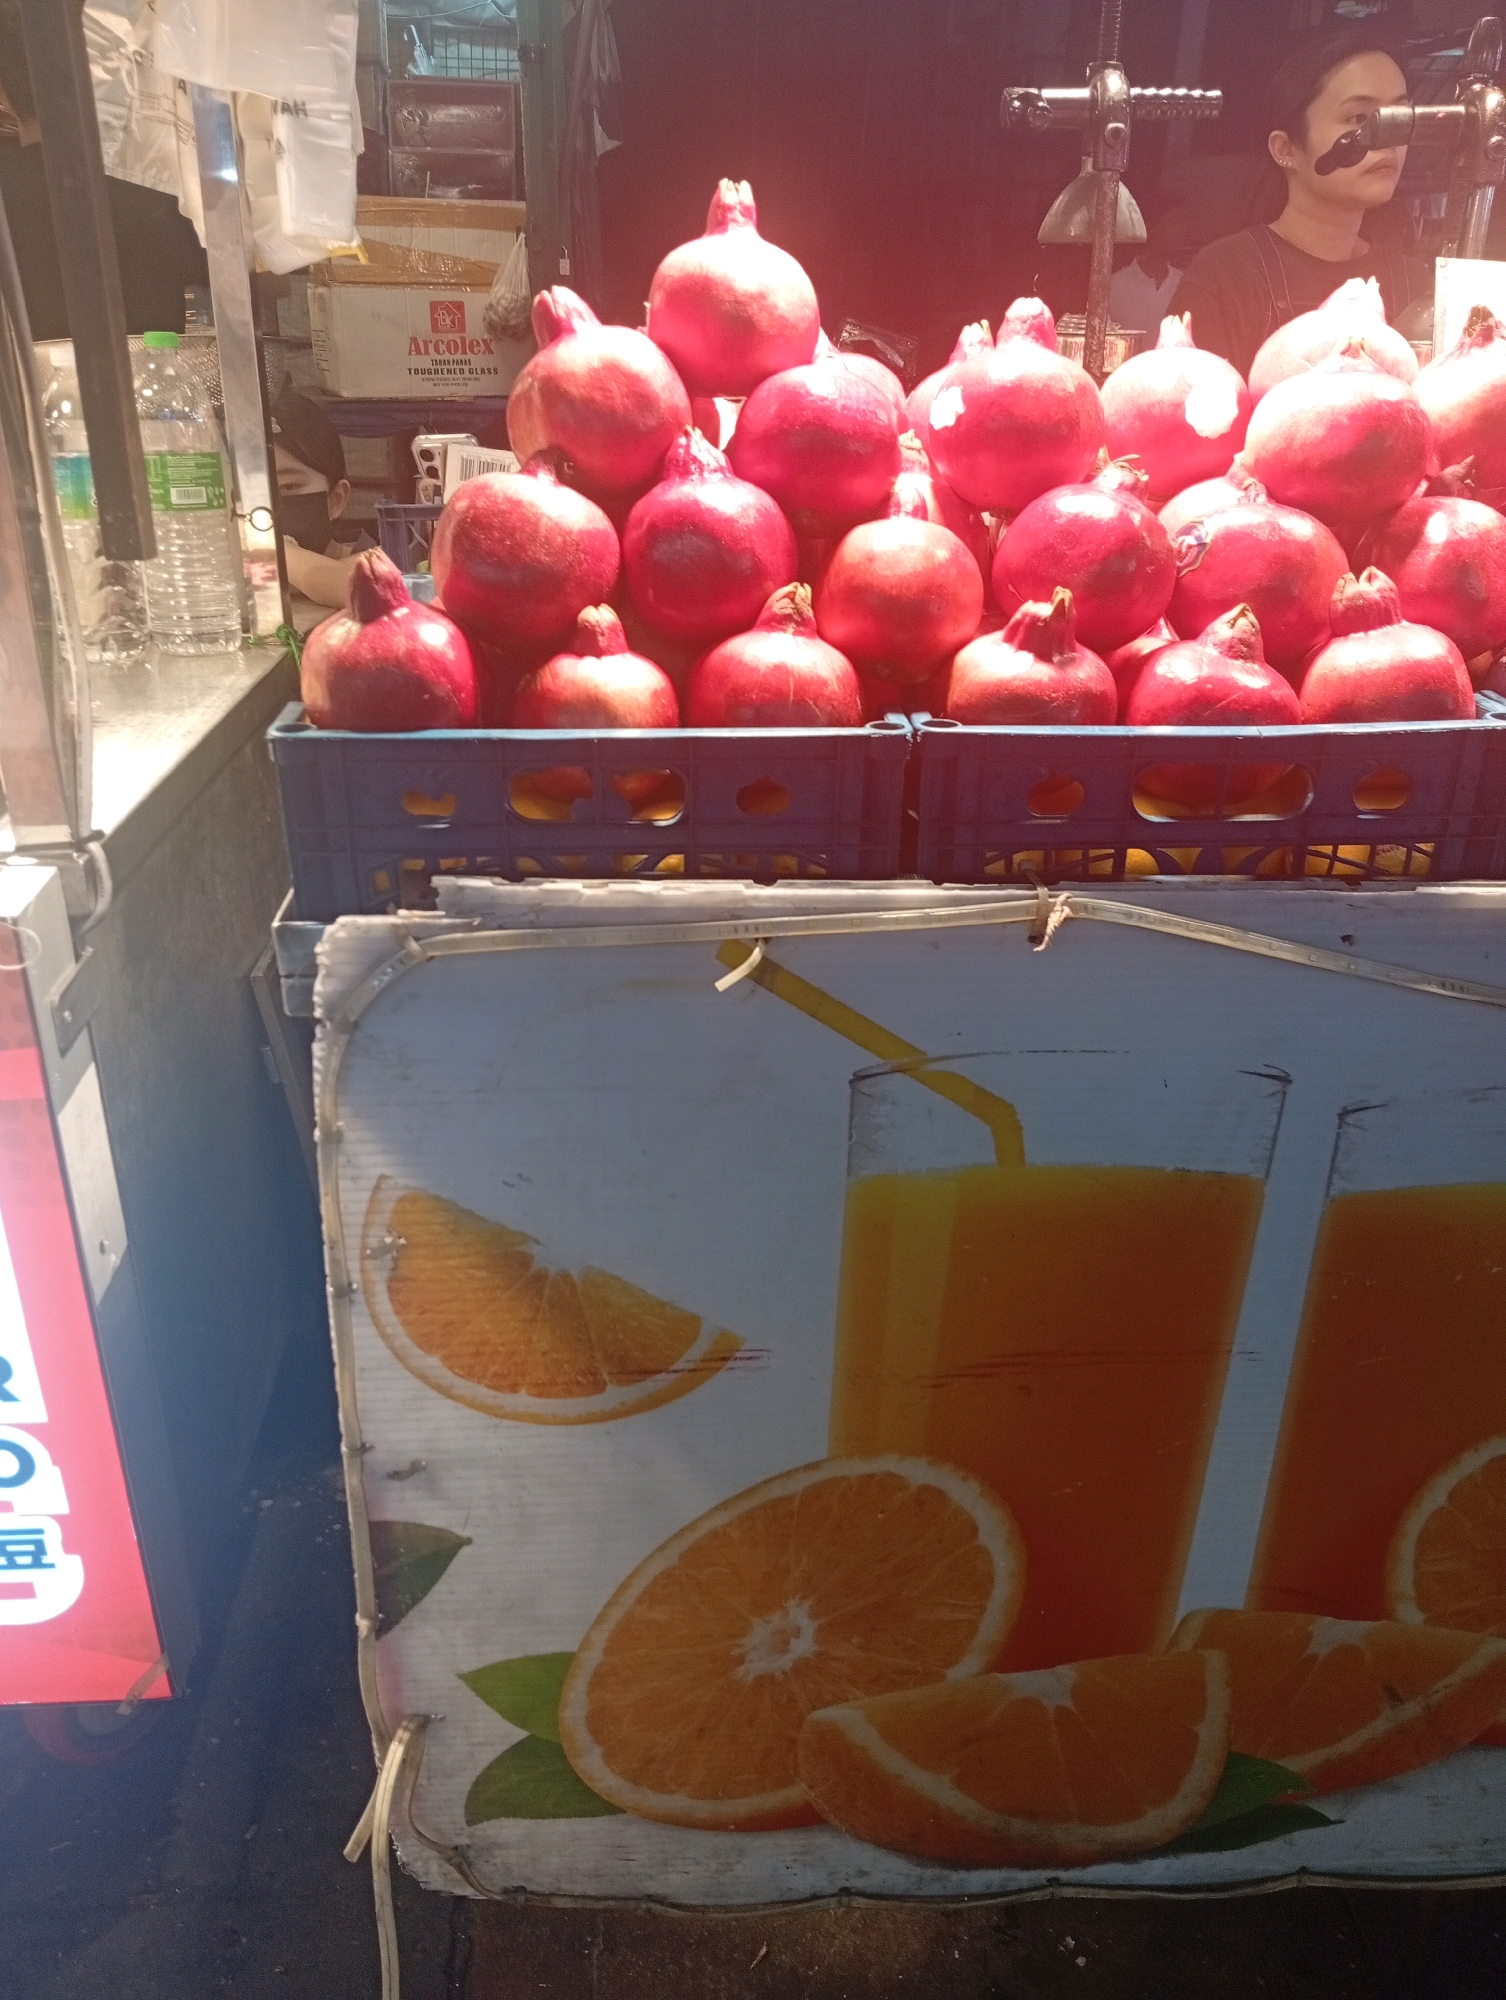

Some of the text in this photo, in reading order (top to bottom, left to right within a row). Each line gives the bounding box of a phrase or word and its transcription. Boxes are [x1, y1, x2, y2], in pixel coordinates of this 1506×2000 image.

[407, 336, 494, 356] Arcolex
[452, 358, 472, 367] PANAS
[407, 367, 499, 376] TOUGHENED GLASS
